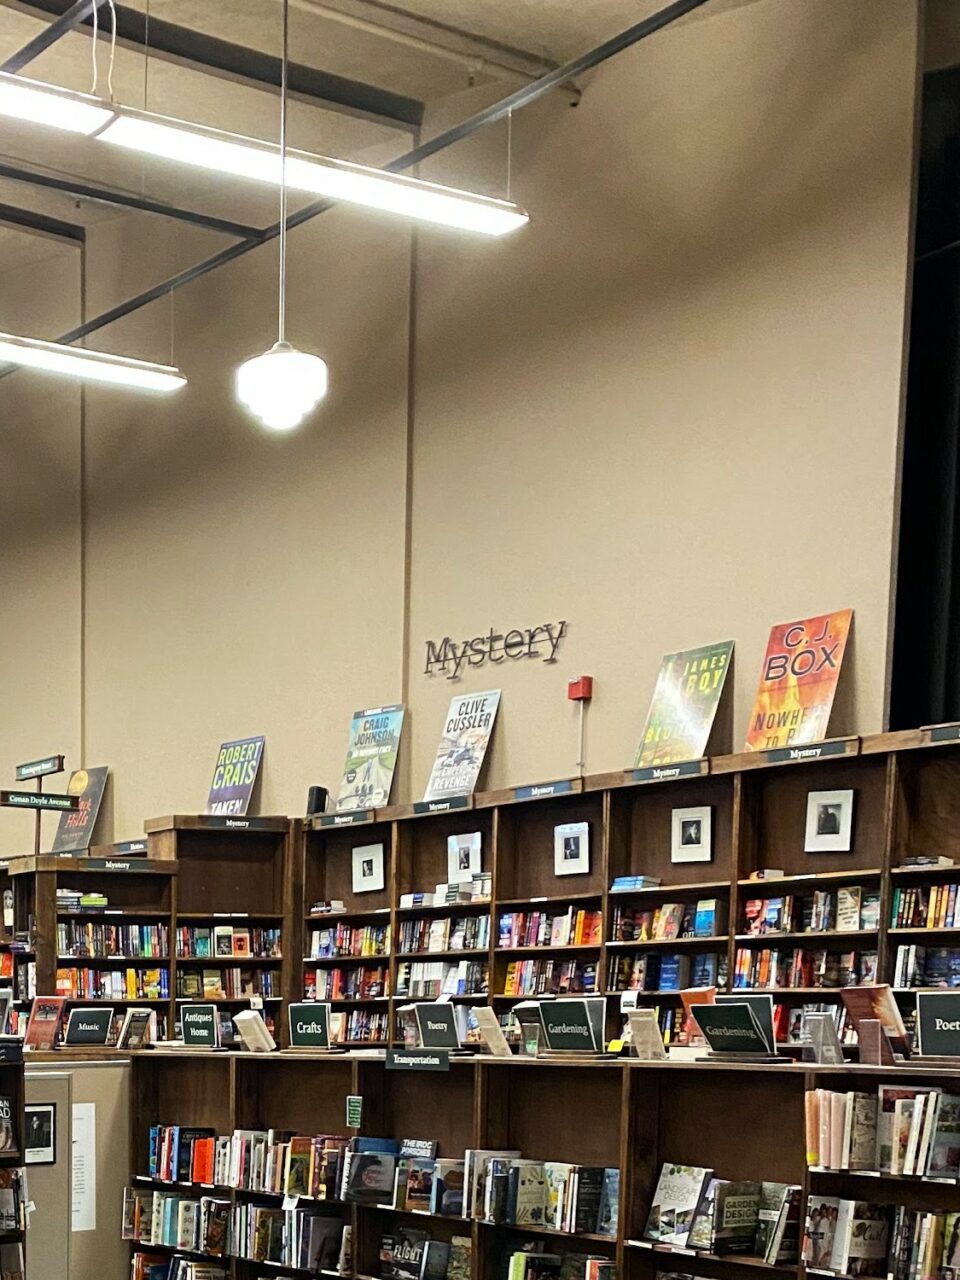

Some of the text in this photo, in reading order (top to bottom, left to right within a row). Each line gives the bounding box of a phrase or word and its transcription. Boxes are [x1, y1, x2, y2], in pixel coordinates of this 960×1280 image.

[785, 620, 833, 649] C. J.
[424, 621, 567, 679] Mystery
[684, 655, 727, 676] JAMES
[764, 643, 840, 681] BOX
[458, 698, 488, 717] CLIVE
[363, 716, 389, 732] CRAIG
[446, 713, 492, 733] CUSSLER
[354, 728, 395, 746] JOHNSON
[219, 742, 262, 765] ROBERT
[790, 748, 821, 760] Mystery
[213, 760, 257, 790] CRAIS
[653, 768, 680, 778] Mystery
[433, 775, 471, 790] REVENGE
[531, 786, 555, 796] Mystery
[9, 796, 30, 804] Conan
[30, 796, 48, 806] Doyle
[211, 799, 243, 815] TAKEN
[429, 801, 450, 811] Mystery
[66, 810, 89, 829] Hills
[226, 819, 250, 829] Mystery
[334, 815, 354, 824] Mystery
[105, 861, 130, 870] Mystery
[185, 1012, 212, 1023] Antiques
[77, 1022, 100, 1032] Music
[297, 1022, 322, 1034] Crafts
[427, 1020, 448, 1032] Poetry
[548, 1022, 589, 1037] Gardening
[935, 1018, 960, 1030] Poet
[191, 1028, 208, 1037] Home
[705, 1025, 757, 1040] Gardening
[393, 1054, 440, 1066] Transportation
[725, 1199, 758, 1210] GARDEN
[725, 1208, 758, 1219] DESIGN
[393, 1244, 422, 1261] FLIGHT
